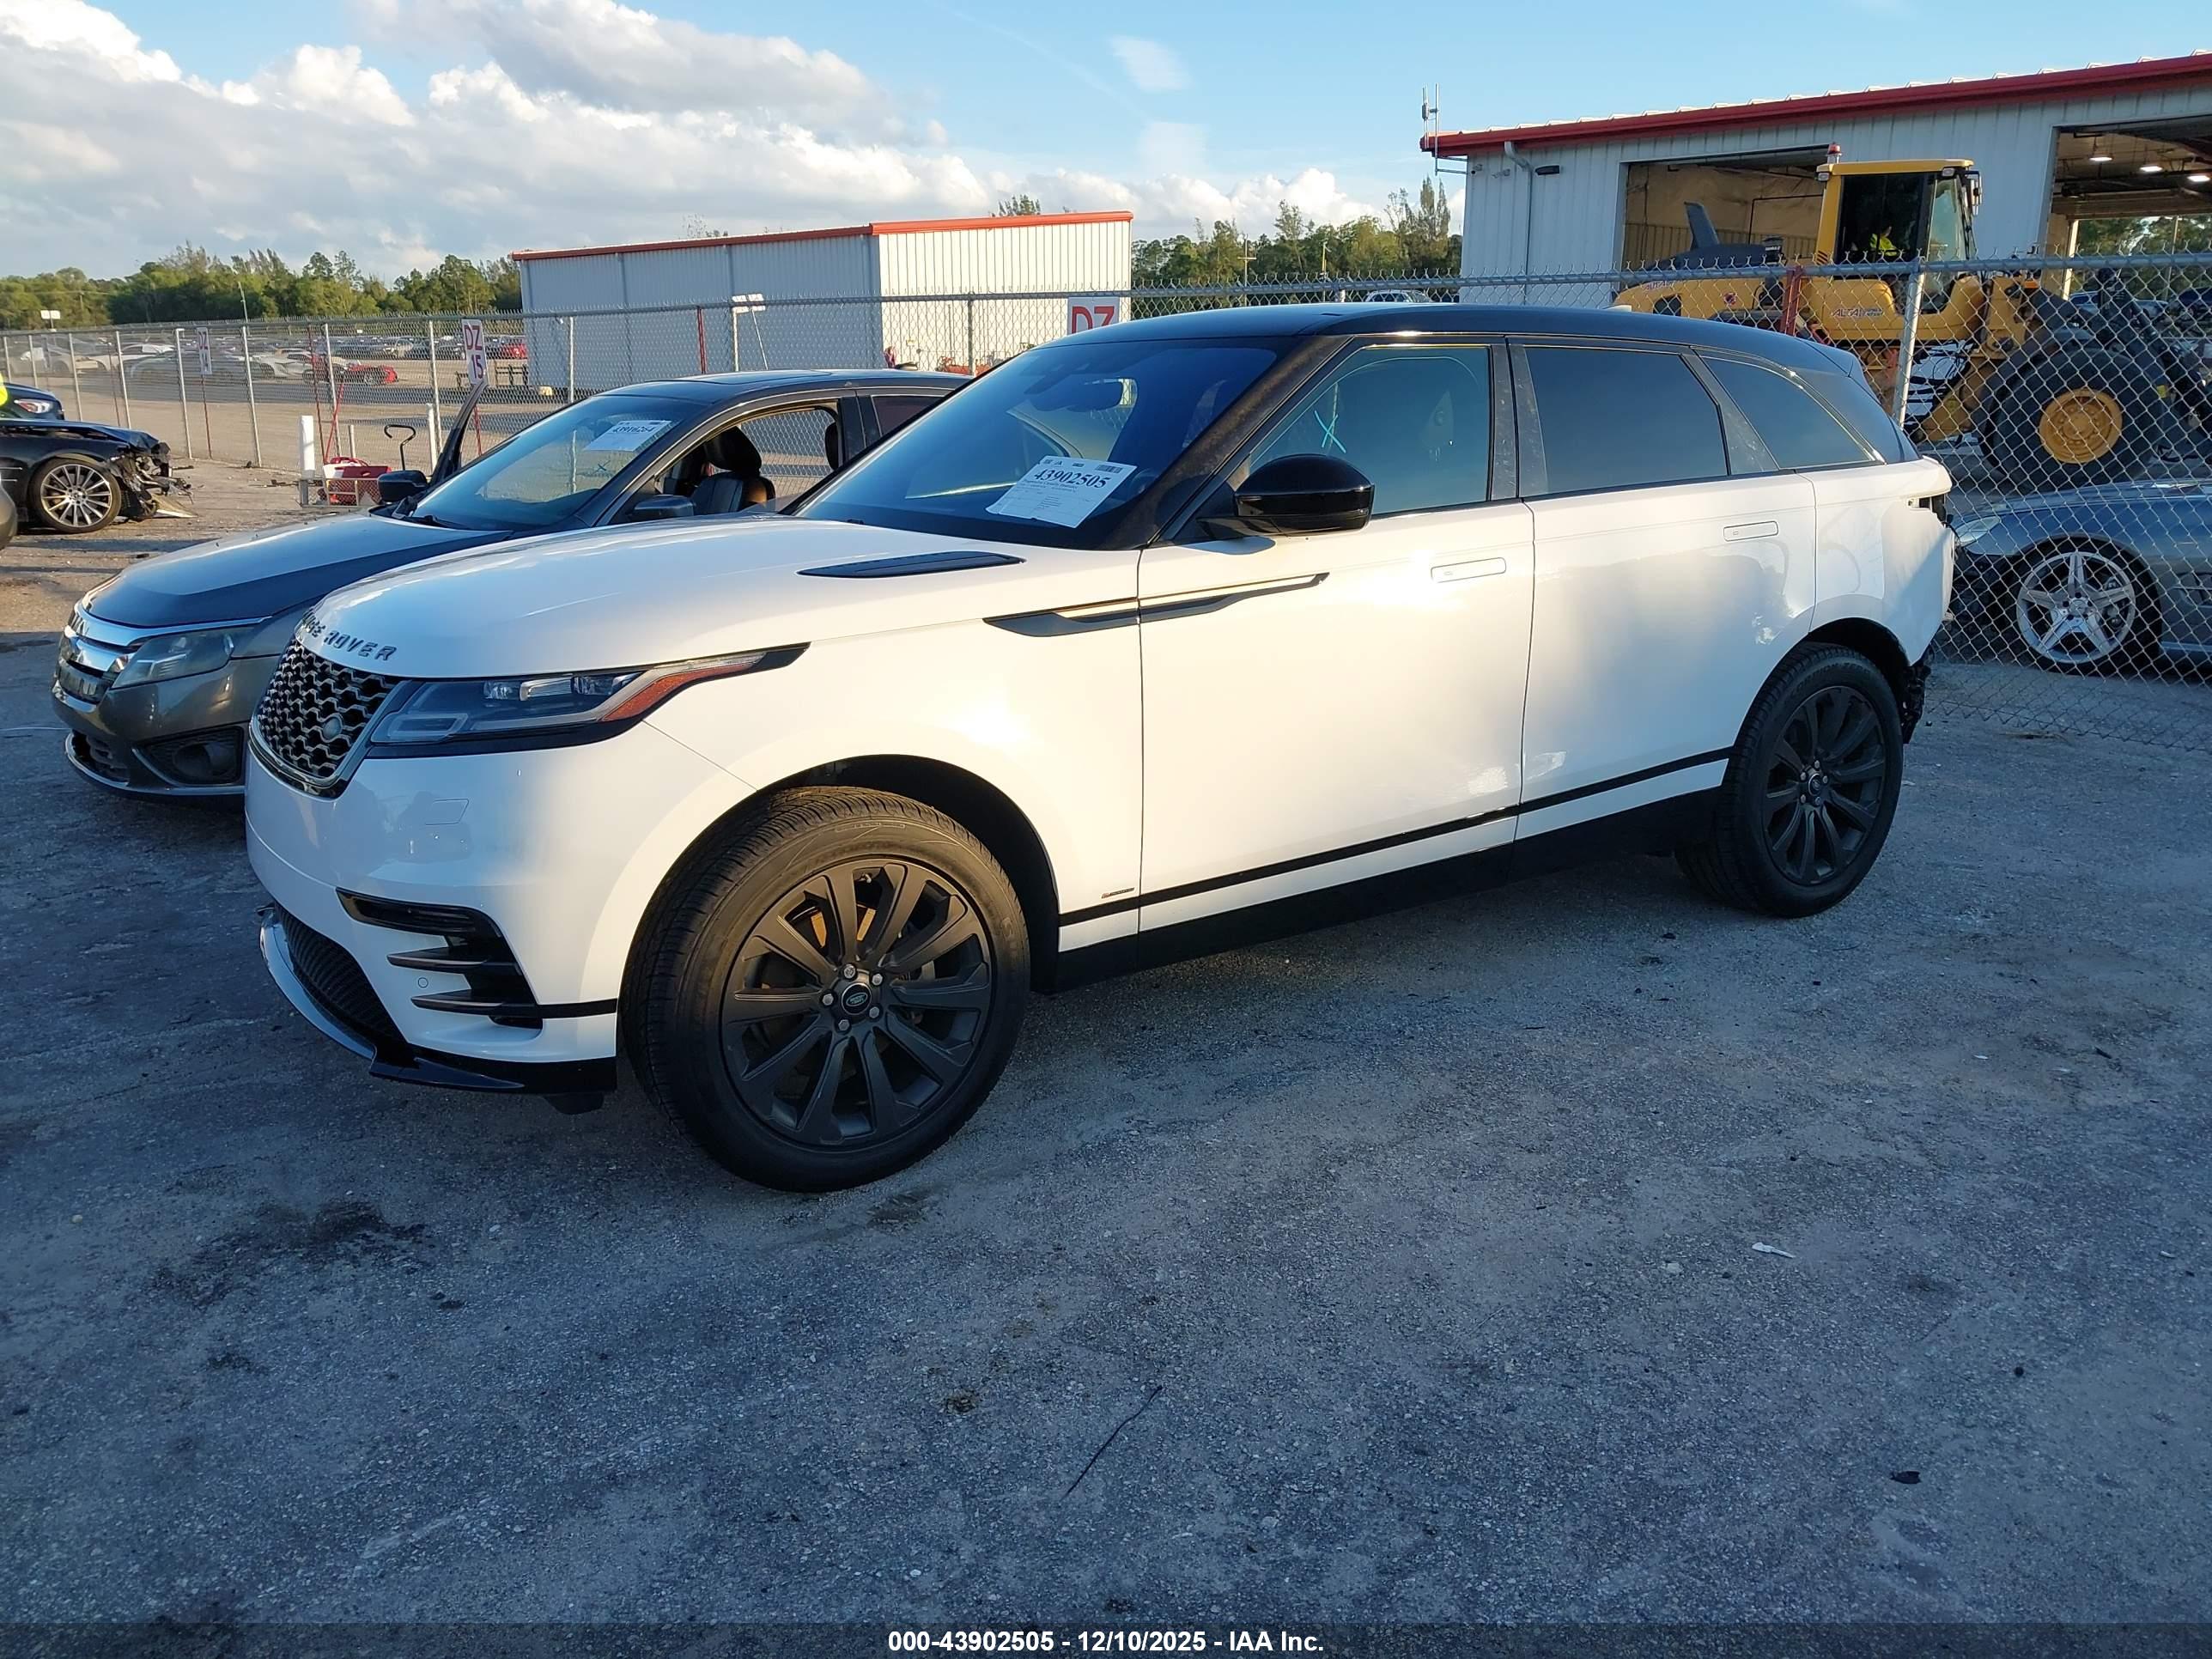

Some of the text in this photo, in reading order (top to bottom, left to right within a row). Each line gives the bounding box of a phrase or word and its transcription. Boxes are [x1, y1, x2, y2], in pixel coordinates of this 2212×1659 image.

[1071, 306, 1115, 334] DZ
[464, 325, 483, 350] DZ
[471, 355, 483, 379] 15
[1035, 469, 1112, 489] 43902505
